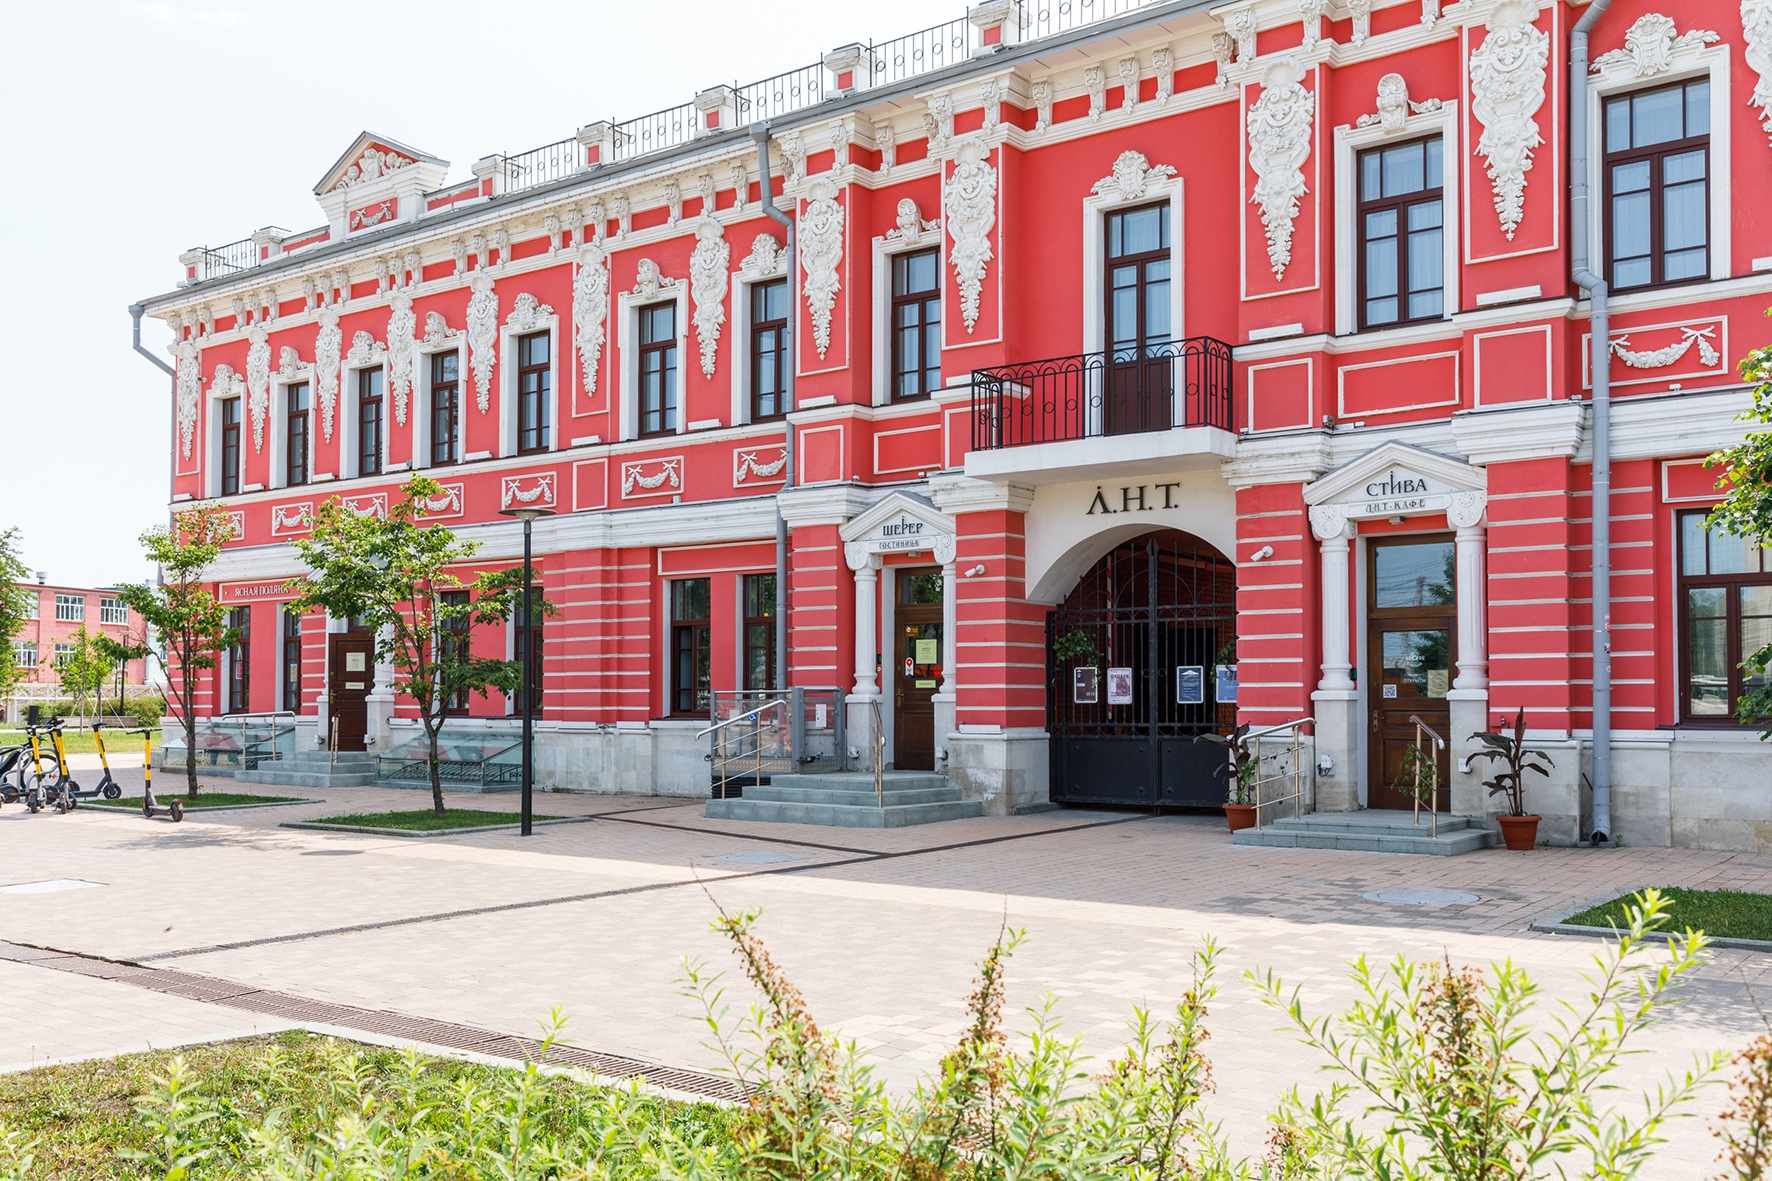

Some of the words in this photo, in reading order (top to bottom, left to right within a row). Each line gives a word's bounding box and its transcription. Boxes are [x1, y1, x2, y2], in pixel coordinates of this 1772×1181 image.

[1366, 471, 1427, 496] СТИВА
[883, 515, 923, 536] ШЕРЕР
[879, 540, 919, 549] ГОСТИНИЦА
[235, 587, 258, 597] ЯСНАЯ
